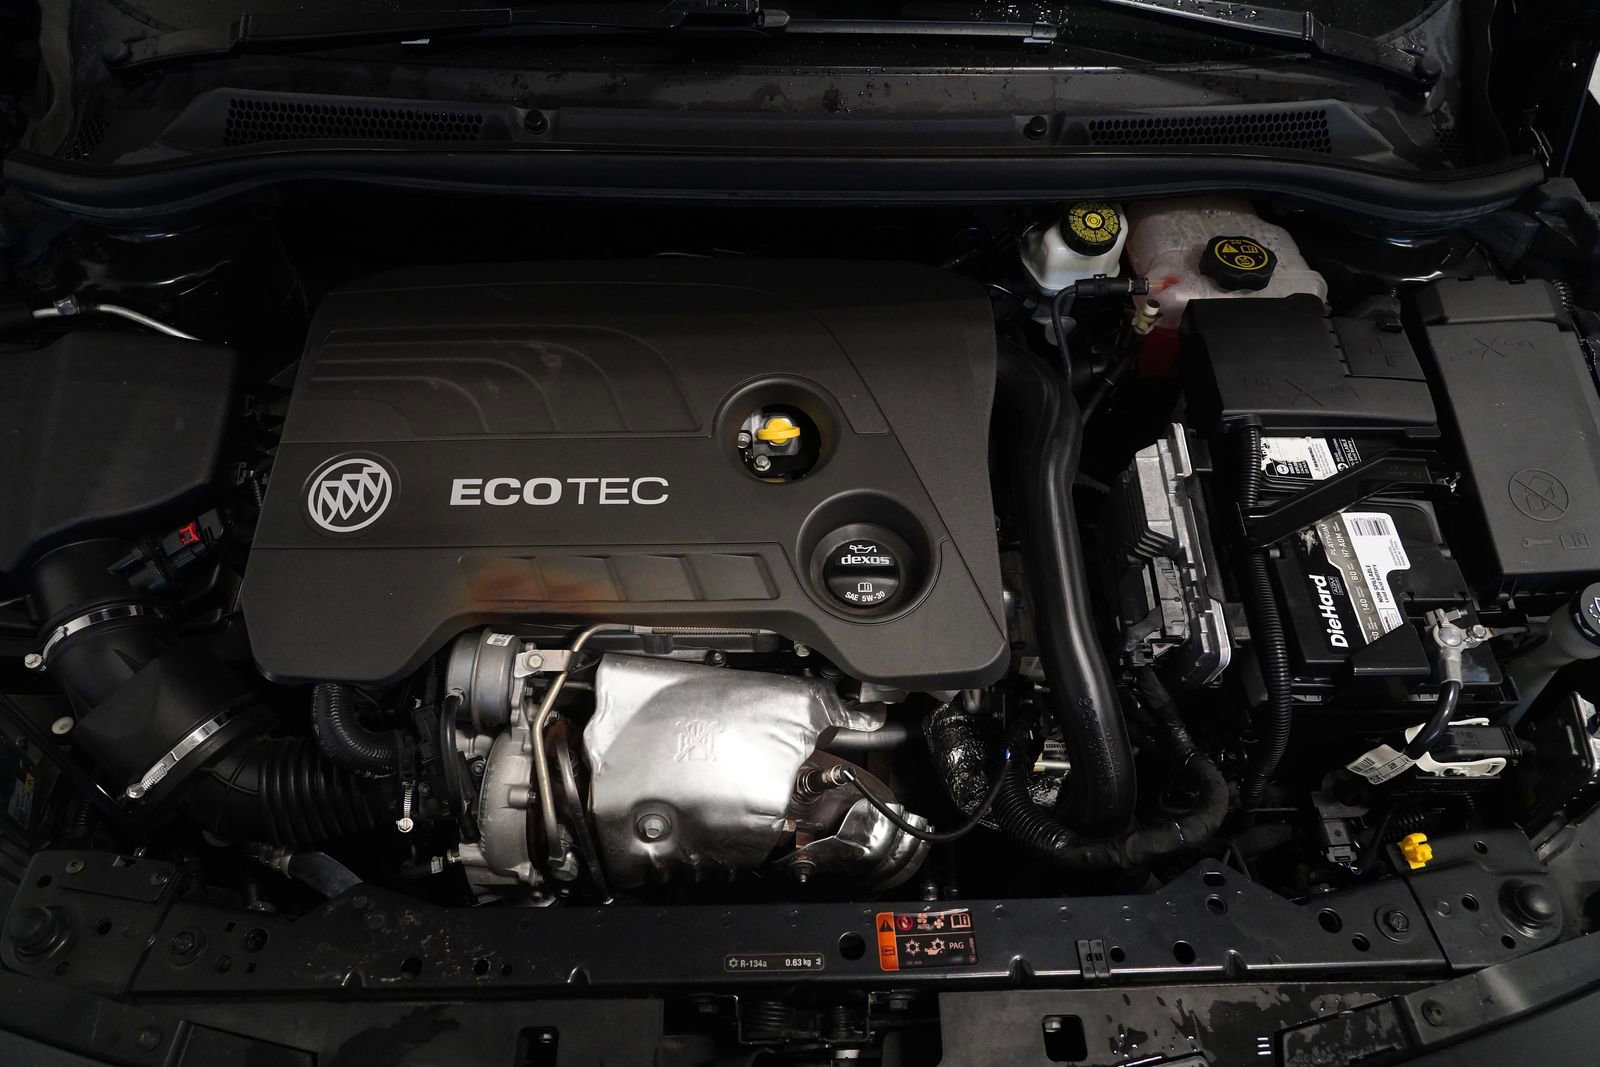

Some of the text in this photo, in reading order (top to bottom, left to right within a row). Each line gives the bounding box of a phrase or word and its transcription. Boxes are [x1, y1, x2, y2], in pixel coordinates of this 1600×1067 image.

[450, 477, 669, 506] ECOTEC
[1320, 523, 1337, 556] PLATINUM
[841, 555, 890, 565] dexos
[1364, 564, 1384, 603] NON-SPILLABLE
[845, 590, 886, 602] SAE 5W-30
[1308, 574, 1349, 647] DieHard
[1359, 598, 1370, 612] 140
[948, 941, 965, 951] PAG
[740, 958, 812, 968] R-134a 0.63 kg
